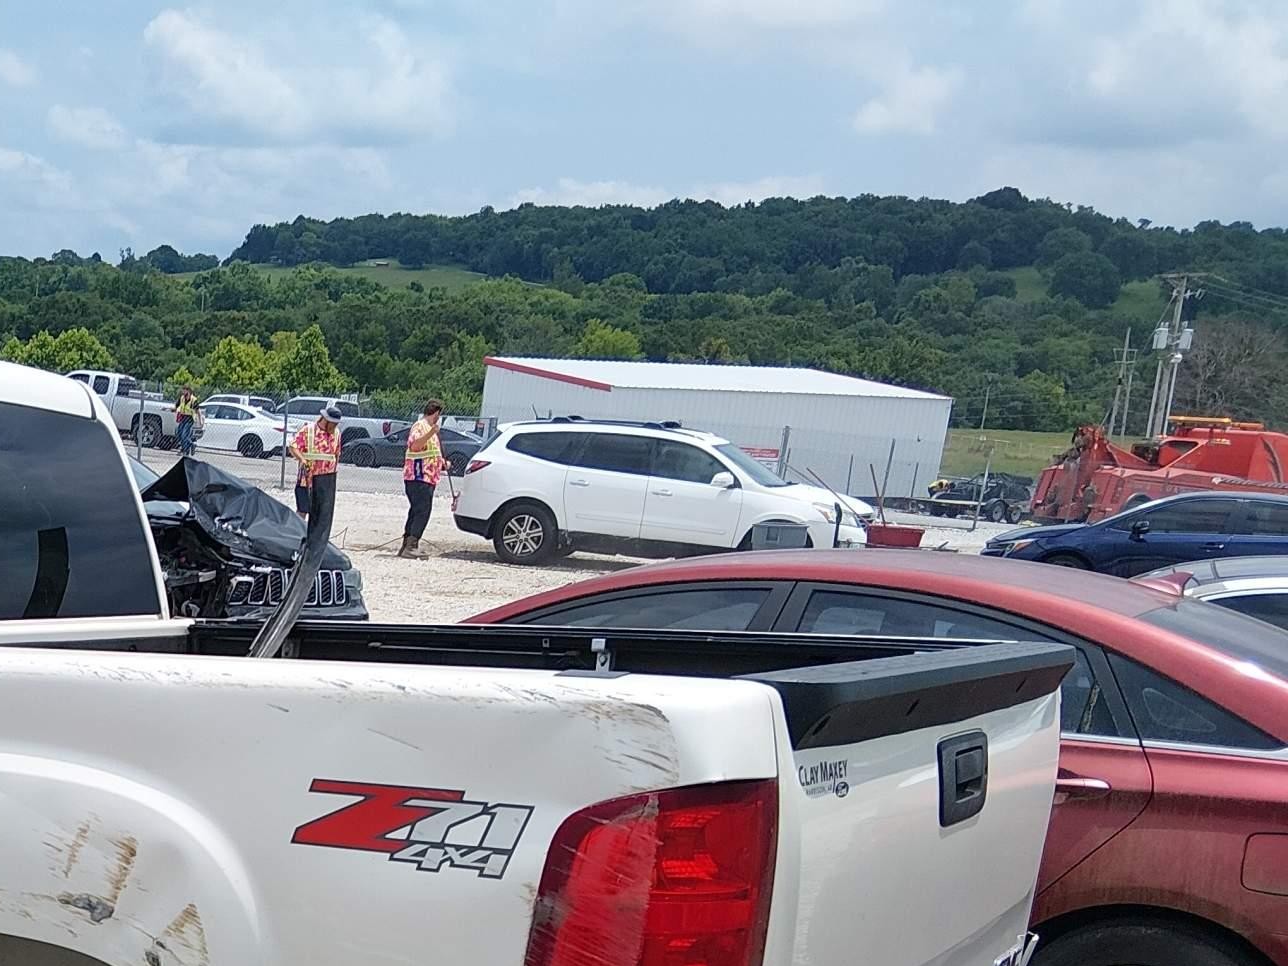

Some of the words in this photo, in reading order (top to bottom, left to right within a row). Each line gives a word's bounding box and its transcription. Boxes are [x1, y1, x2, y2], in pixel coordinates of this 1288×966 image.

[798, 765, 819, 787] CLAY
[819, 759, 848, 793] MAXEY
[291, 778, 535, 852] Z71
